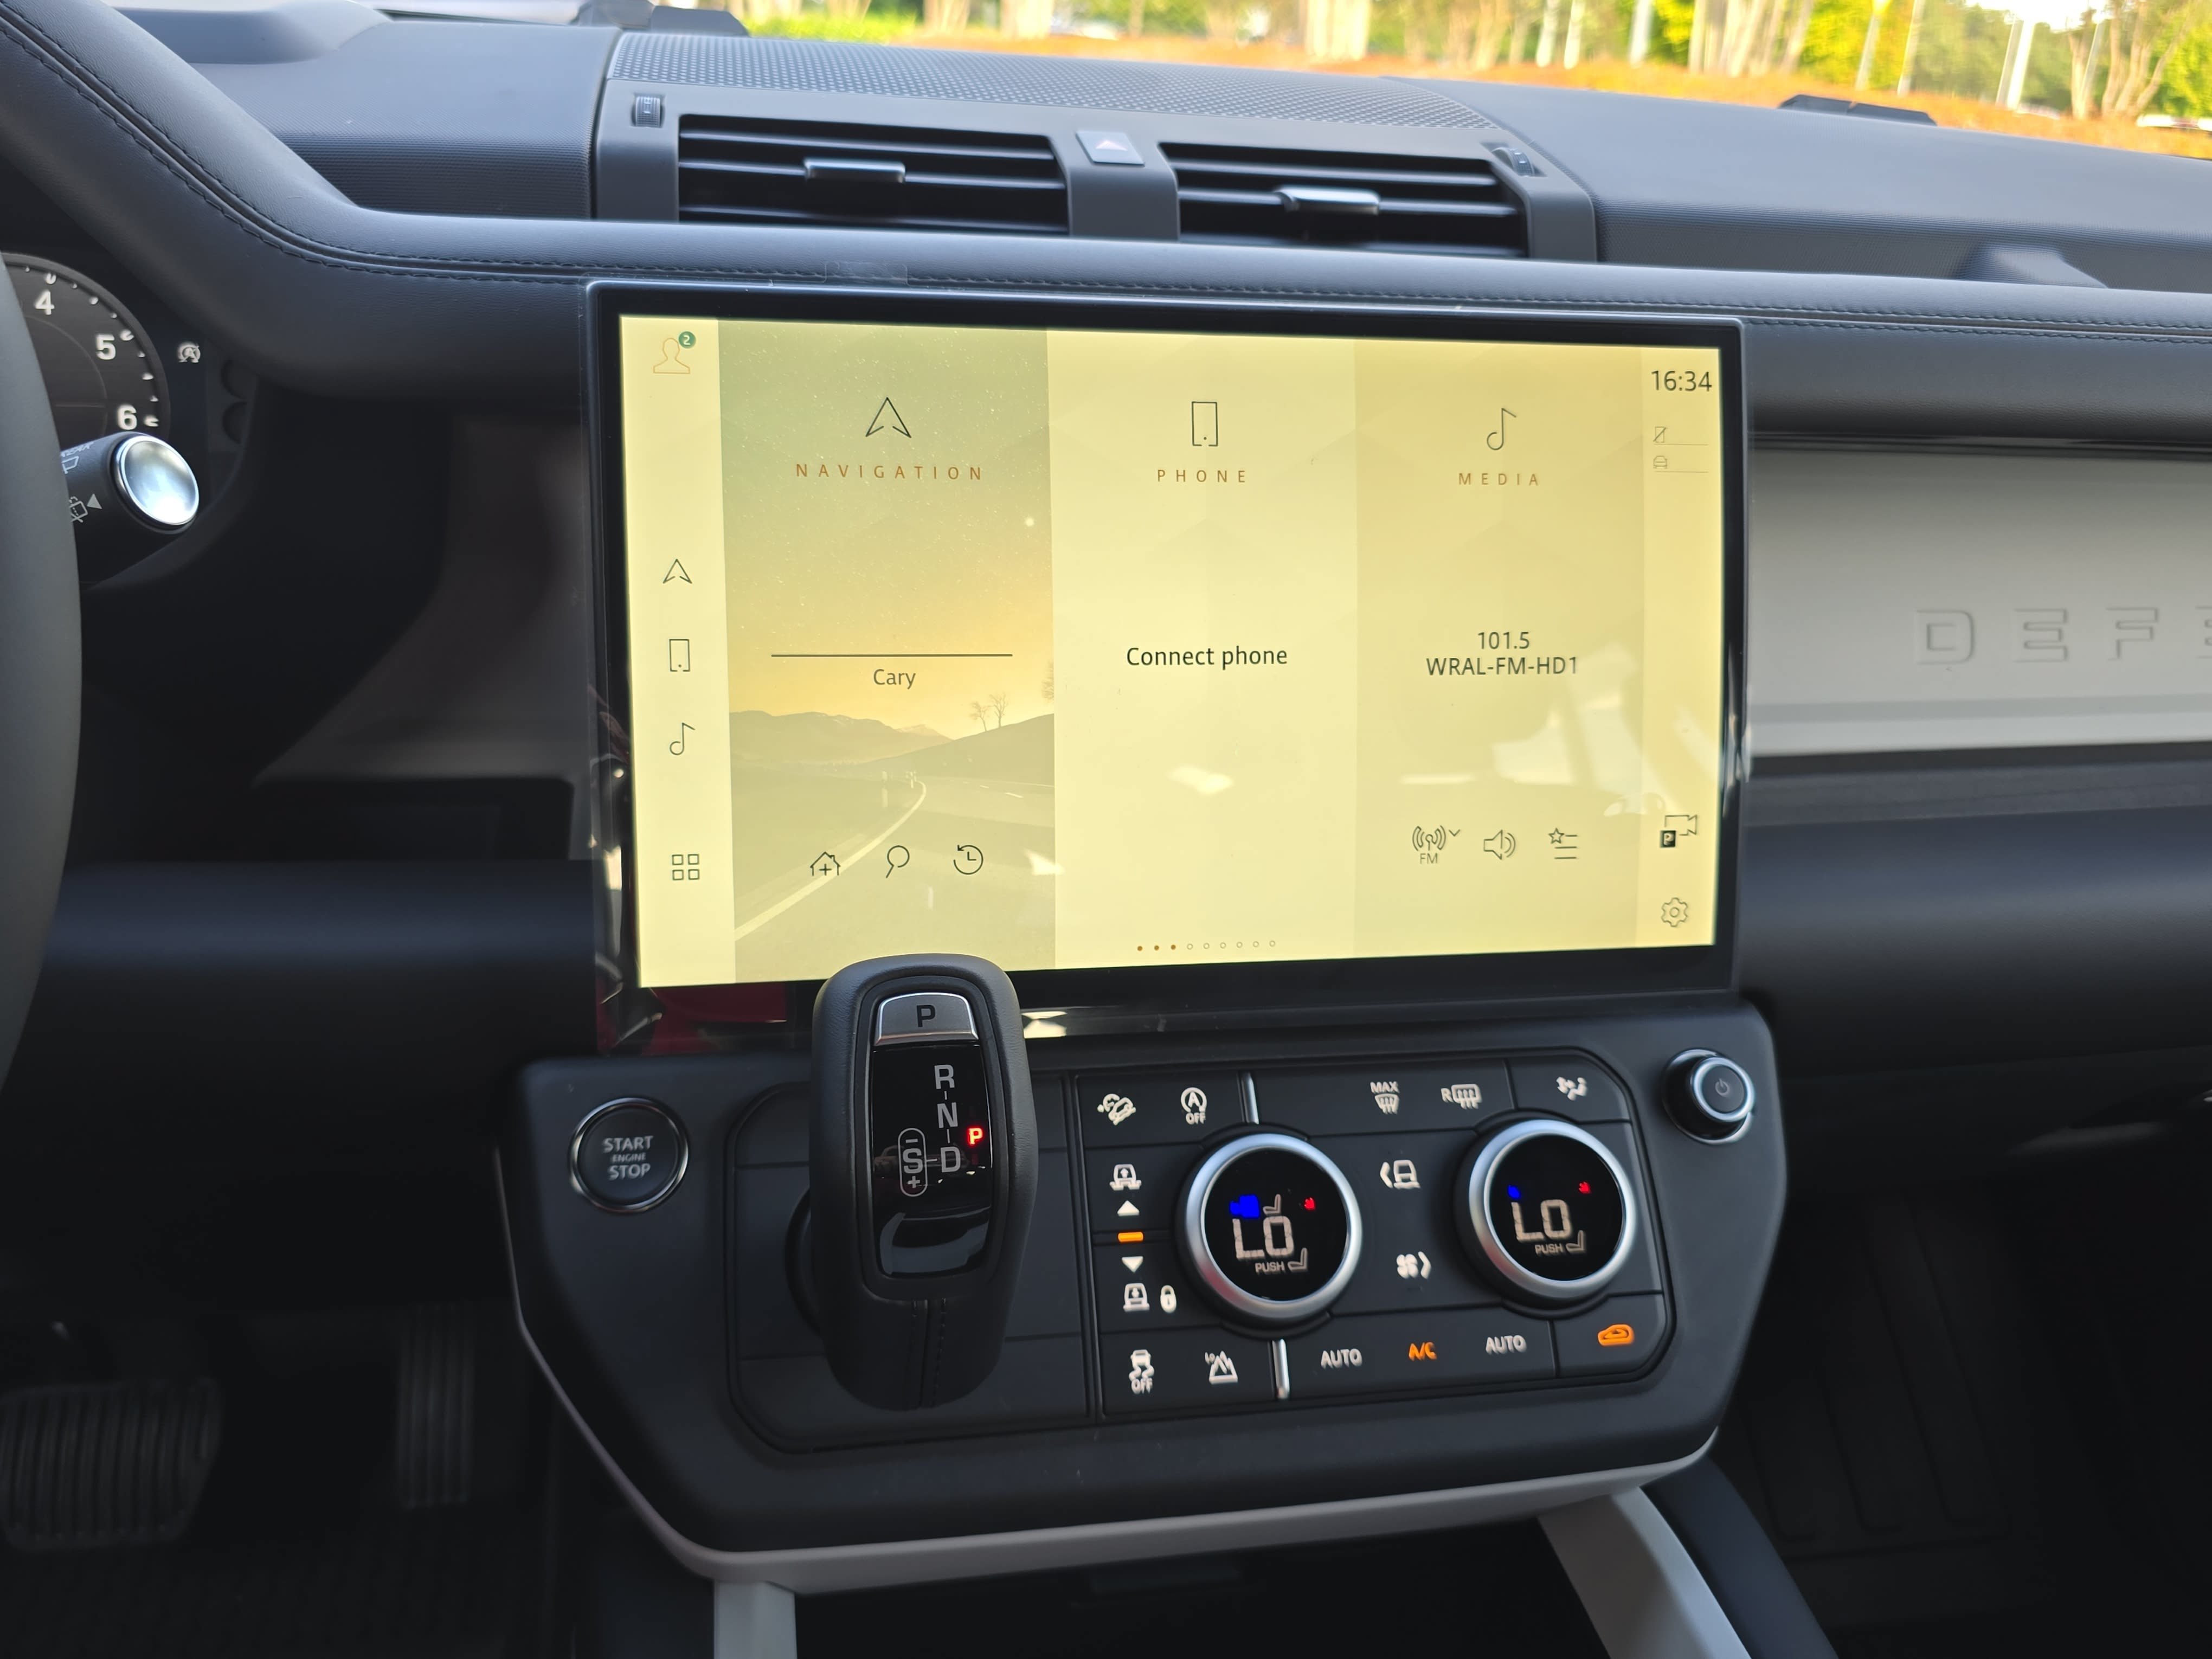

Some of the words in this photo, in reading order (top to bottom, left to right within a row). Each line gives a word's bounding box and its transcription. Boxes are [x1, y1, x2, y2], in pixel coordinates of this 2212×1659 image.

[34, 290, 55, 315] 4
[95, 334, 116, 360] 5
[683, 335, 691, 345] 2
[1651, 371, 1713, 393] 16:34
[117, 404, 137, 430] 6
[796, 464, 981, 481] NAVIGATION
[1157, 470, 1246, 483] PHONE
[1458, 473, 1539, 486] MEDIA
[1477, 631, 1530, 650] 101.5
[1126, 646, 1215, 666] Connect
[1221, 646, 1288, 670] phone
[1426, 657, 1578, 676] WRAL-FM-HD1
[873, 668, 916, 690] Cary
[1663, 832, 1674, 845] P
[1419, 853, 1438, 864] FM
[916, 1005, 935, 1027] P
[934, 1064, 955, 1089] R
[1370, 1081, 1400, 1094] MAX
[1441, 1088, 1453, 1103] R
[937, 1102, 958, 1128] N
[1185, 1112, 1206, 1125] OFF
[602, 1135, 653, 1153] START
[968, 1127, 983, 1145] P
[612, 1153, 646, 1162] ENGINE
[902, 1148, 923, 1174] S
[941, 1146, 961, 1173] D
[608, 1163, 651, 1180] STOP
[1511, 1199, 1572, 1242] LO
[1232, 1216, 1294, 1259] LO
[1534, 1243, 1564, 1256] PUSH
[1255, 1261, 1285, 1274] PUSH
[1409, 1342, 1437, 1361] A/C
[1486, 1335, 1526, 1354] AUTO
[1321, 1348, 1362, 1368] AUTO
[1131, 1378, 1153, 1394] OFF
